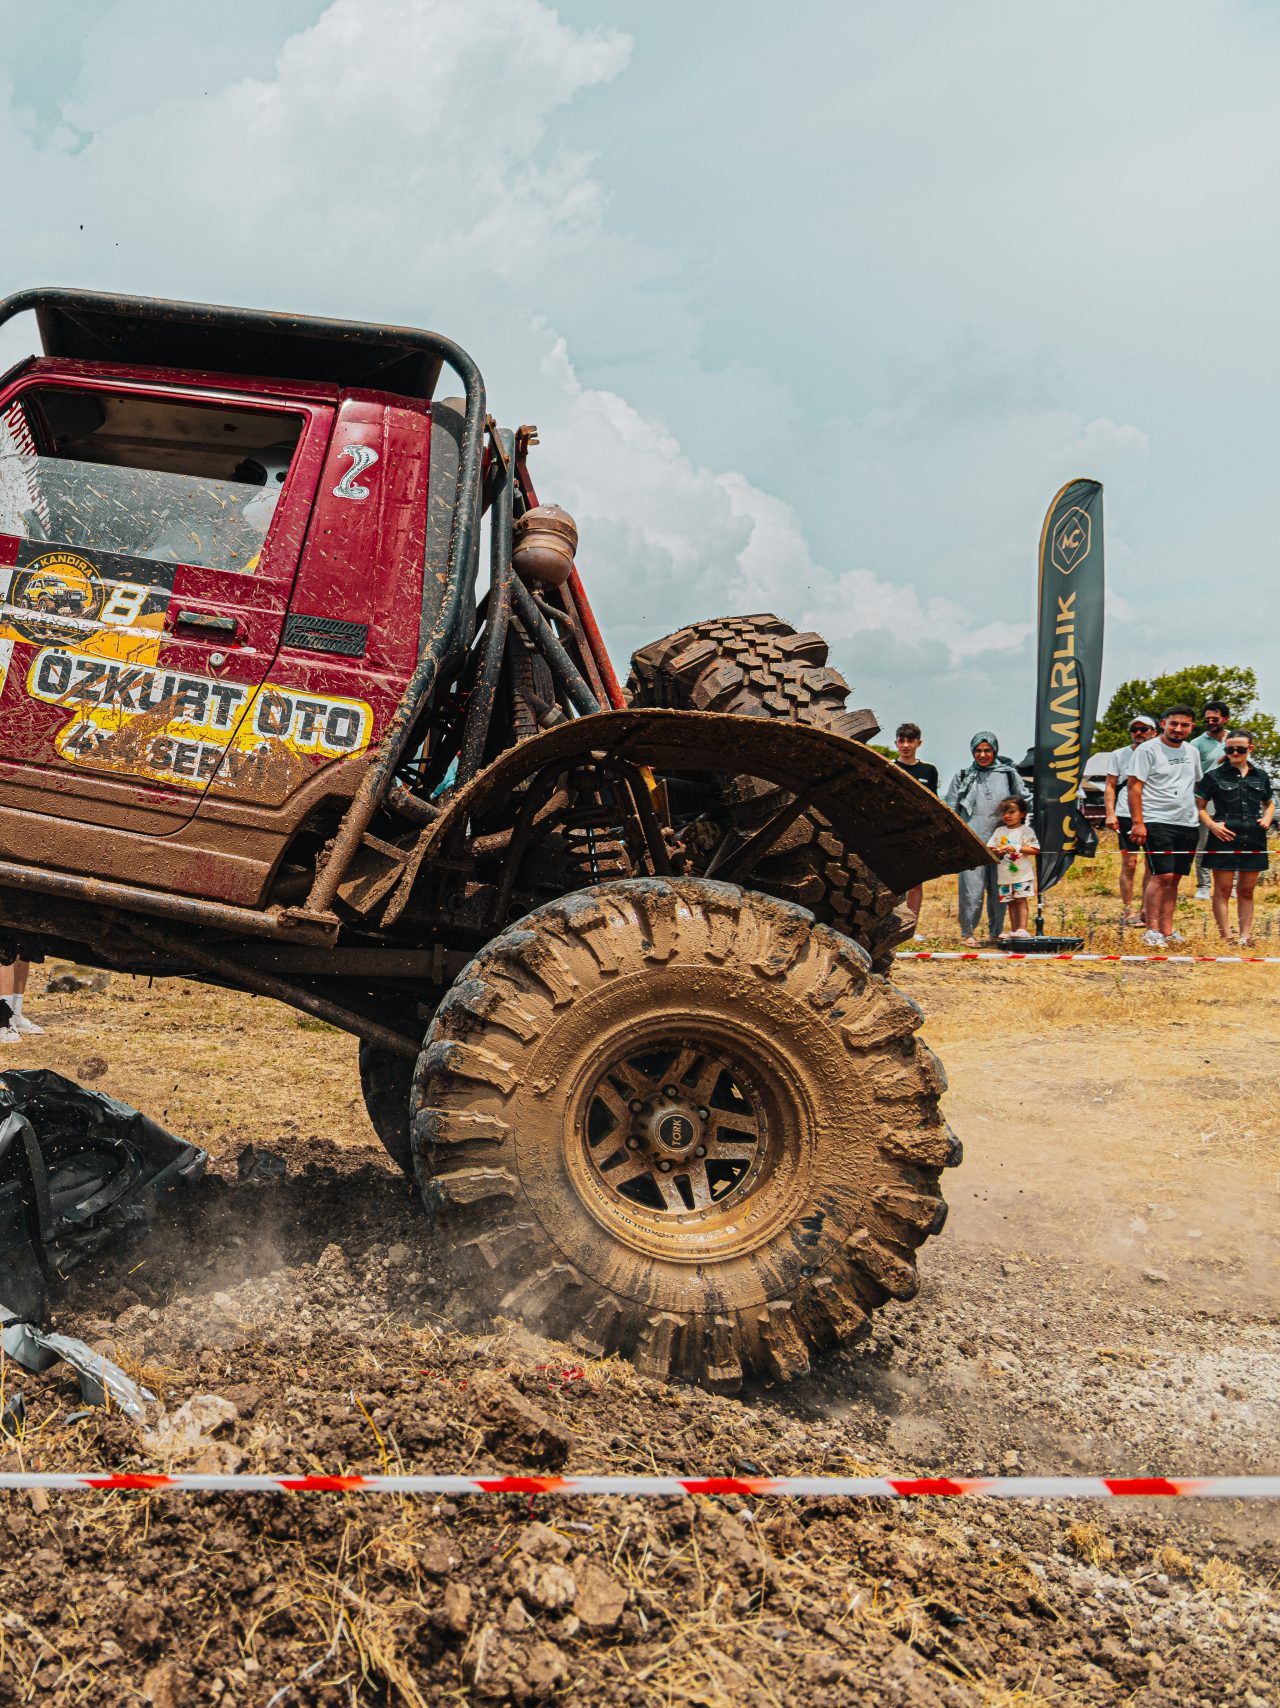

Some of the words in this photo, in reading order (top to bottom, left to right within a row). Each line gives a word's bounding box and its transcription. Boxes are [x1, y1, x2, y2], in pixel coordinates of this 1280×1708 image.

[40, 554, 94, 578] KANDIRA
[100, 582, 149, 626] 8
[37, 648, 245, 726] ÖZKURT
[256, 693, 362, 750] OTO
[672, 1118, 681, 1146] TORK
